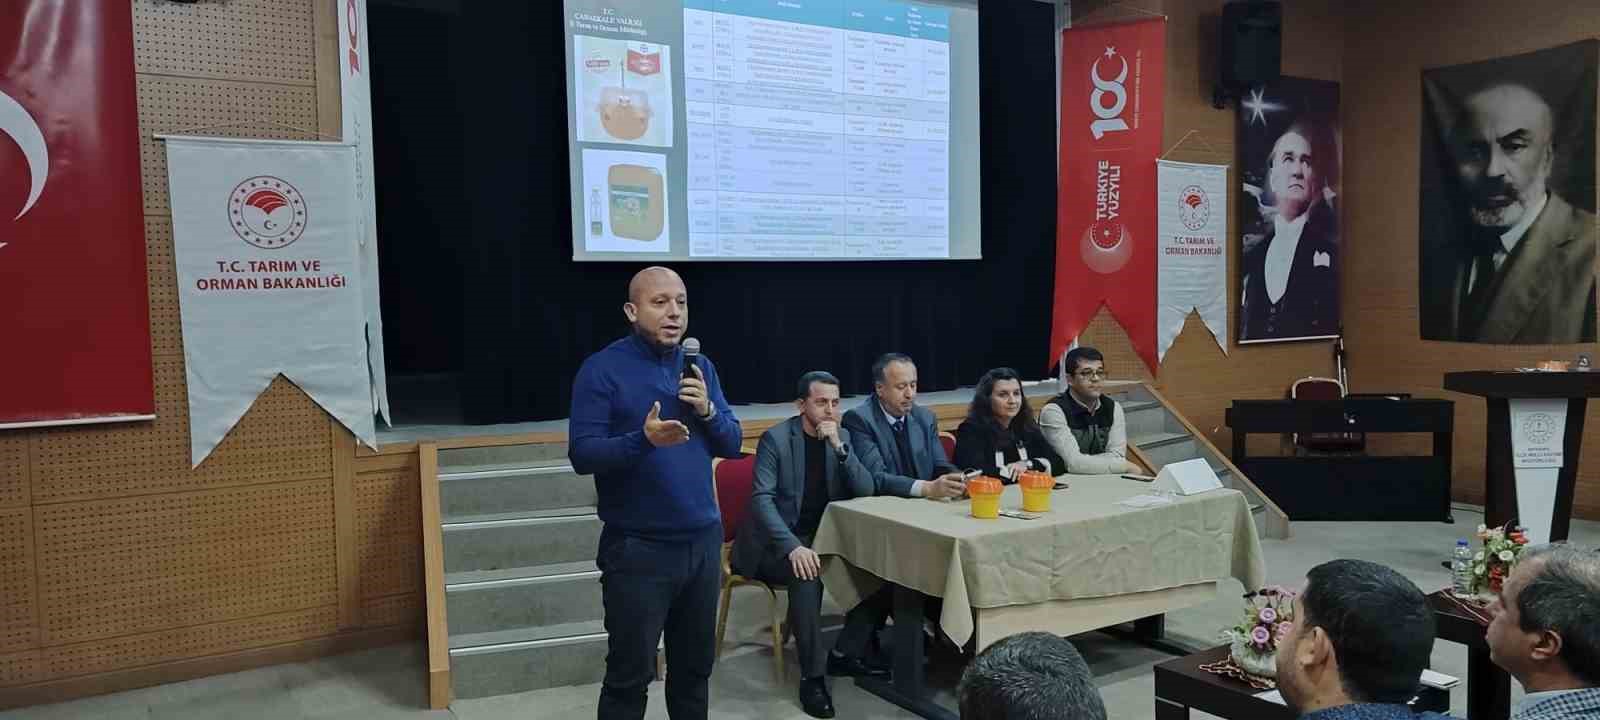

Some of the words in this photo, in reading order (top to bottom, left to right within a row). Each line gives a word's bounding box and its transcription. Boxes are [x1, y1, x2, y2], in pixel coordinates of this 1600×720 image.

[1184, 236, 1205, 245] TARIM
[1206, 237, 1215, 245] VE
[1165, 247, 1189, 255] ORMAN
[216, 260, 245, 273] T.C.
[248, 260, 297, 273] TARIM
[302, 260, 321, 272] VE
[196, 278, 258, 290] ORMAN
[263, 274, 346, 289] BAKANLIĞI
